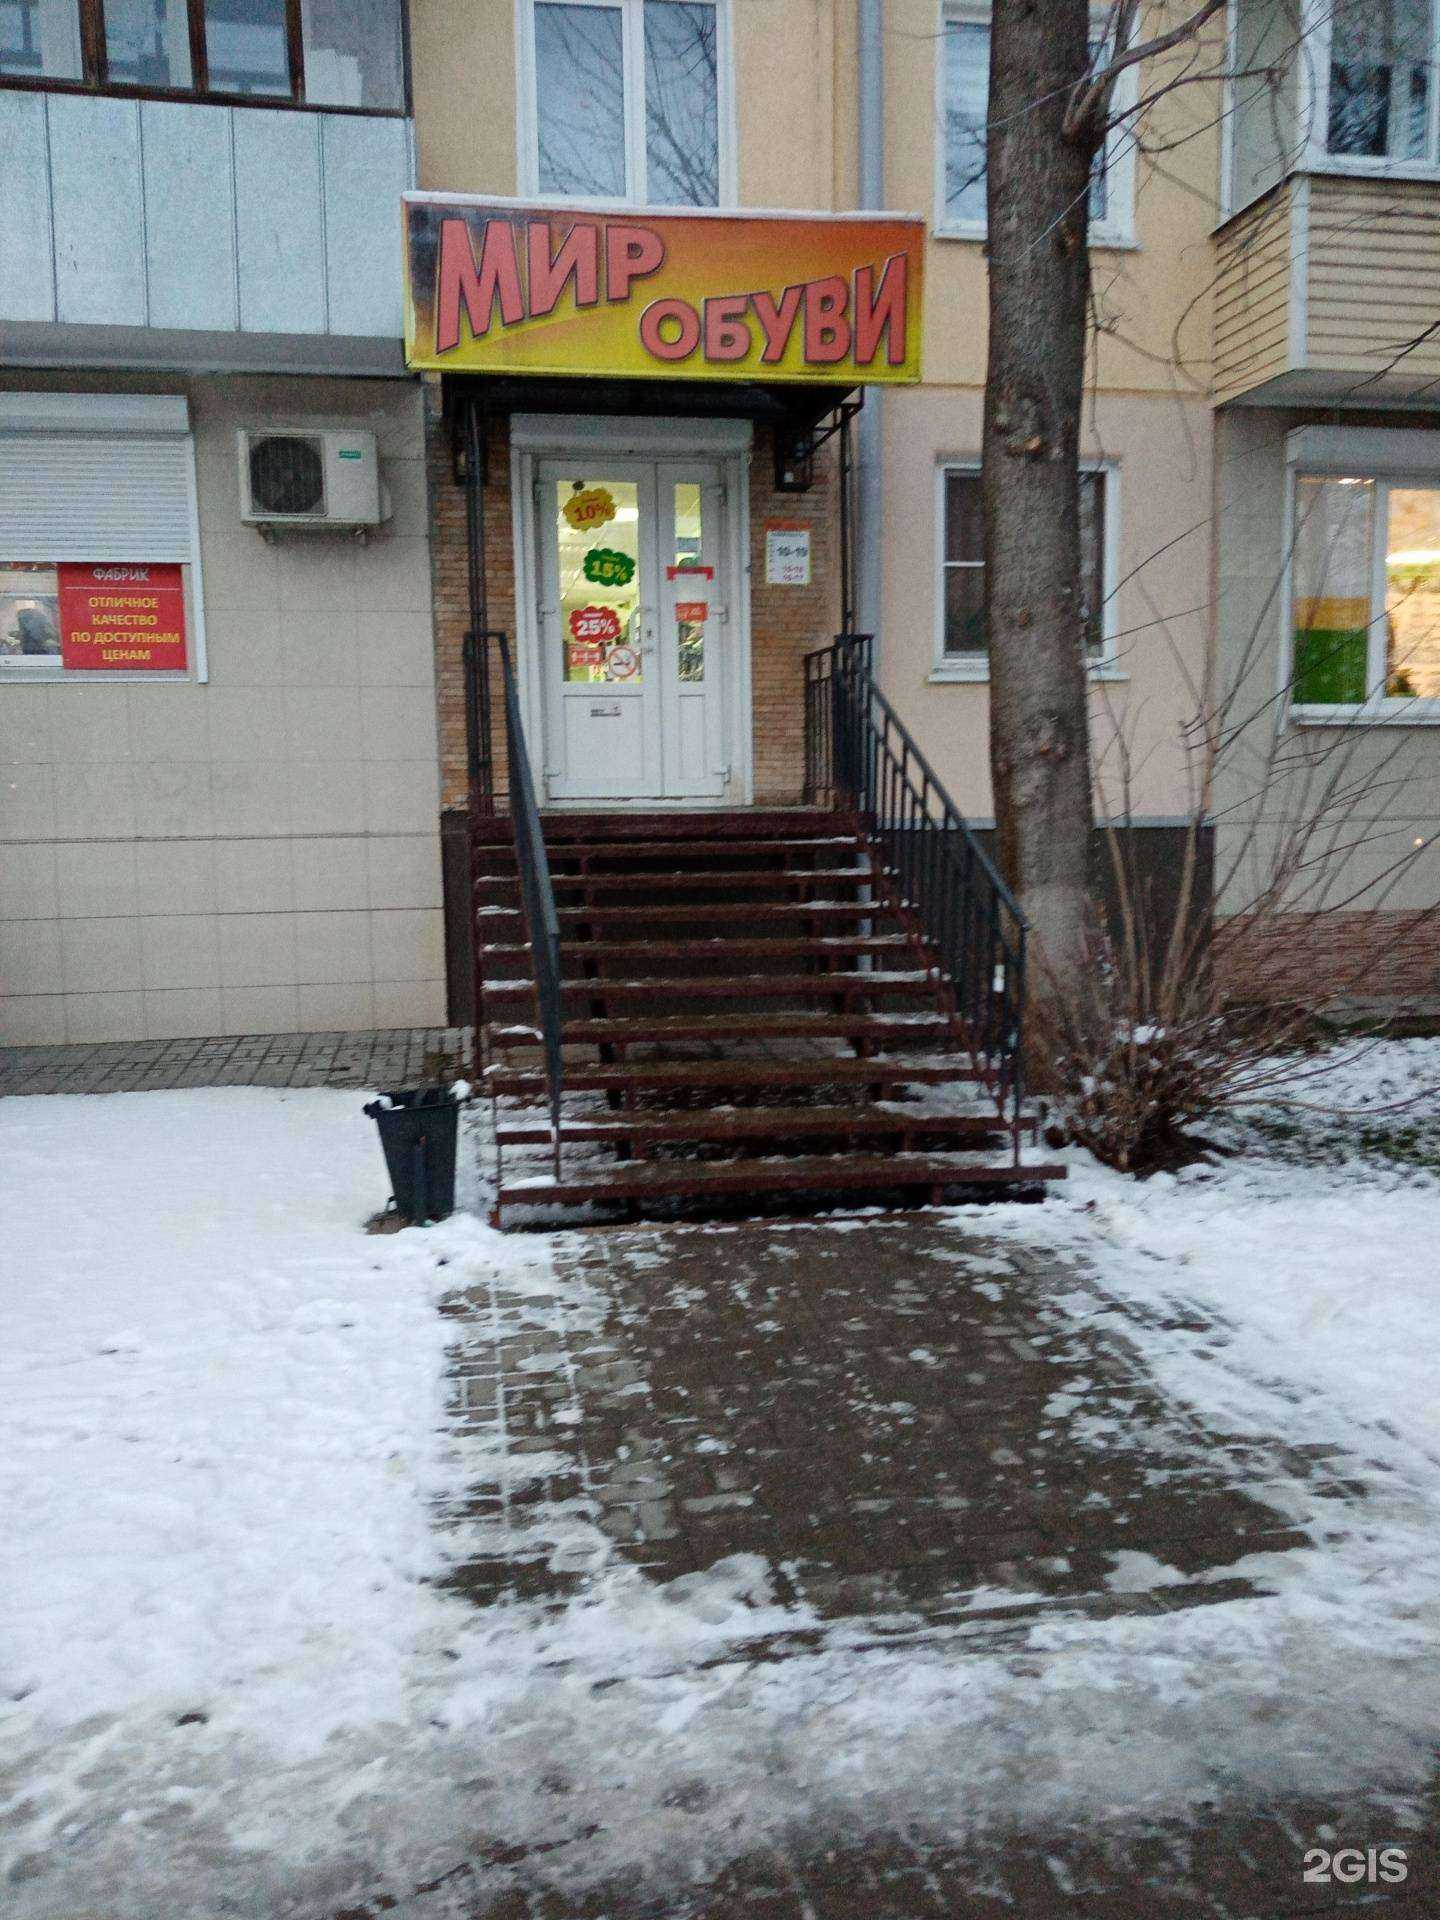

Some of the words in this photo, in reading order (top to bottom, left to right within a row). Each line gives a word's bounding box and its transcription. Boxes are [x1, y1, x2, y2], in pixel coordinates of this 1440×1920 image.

[435, 218, 666, 355] МИР
[639, 251, 909, 366] ОБУВИ
[92, 567, 150, 582] ФАБРИК
[88, 596, 159, 608] ОТЛИЧНОЕ
[91, 614, 158, 626] КАЧЕСТВО
[576, 618, 616, 636] 25%
[70, 631, 91, 643] ПО
[94, 631, 180, 645] ДОСТУПНЫМ
[101, 649, 152, 662] ЦЕНАМ
